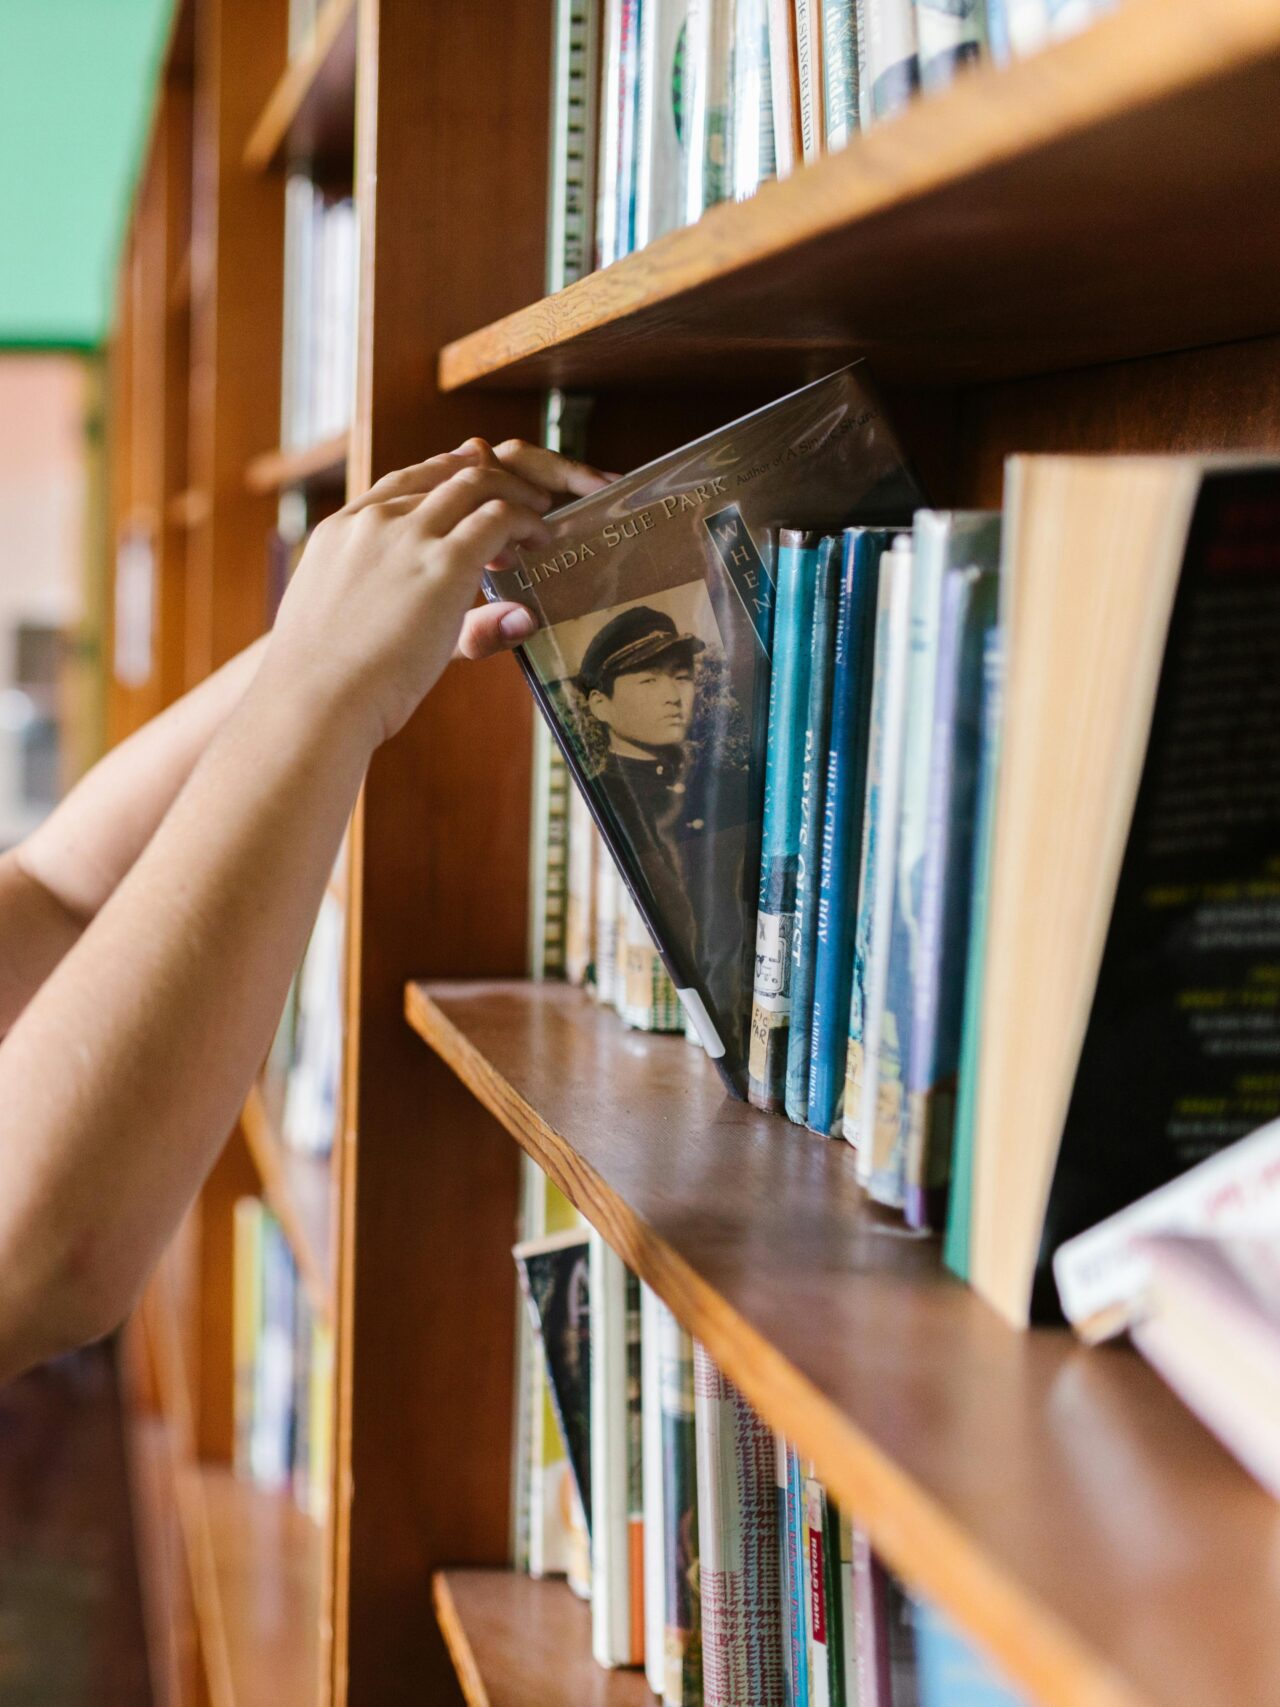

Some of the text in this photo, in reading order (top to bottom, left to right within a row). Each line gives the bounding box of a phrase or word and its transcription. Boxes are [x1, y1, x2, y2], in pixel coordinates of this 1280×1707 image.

[736, 462, 770, 485] Author
[798, 429, 838, 455] Sine
[512, 476, 727, 591] LINDA SUE PARK
[792, 853, 805, 968] QUEST
[817, 898, 829, 943] BOY
[811, 1537, 820, 1633] ROALD DAHL
